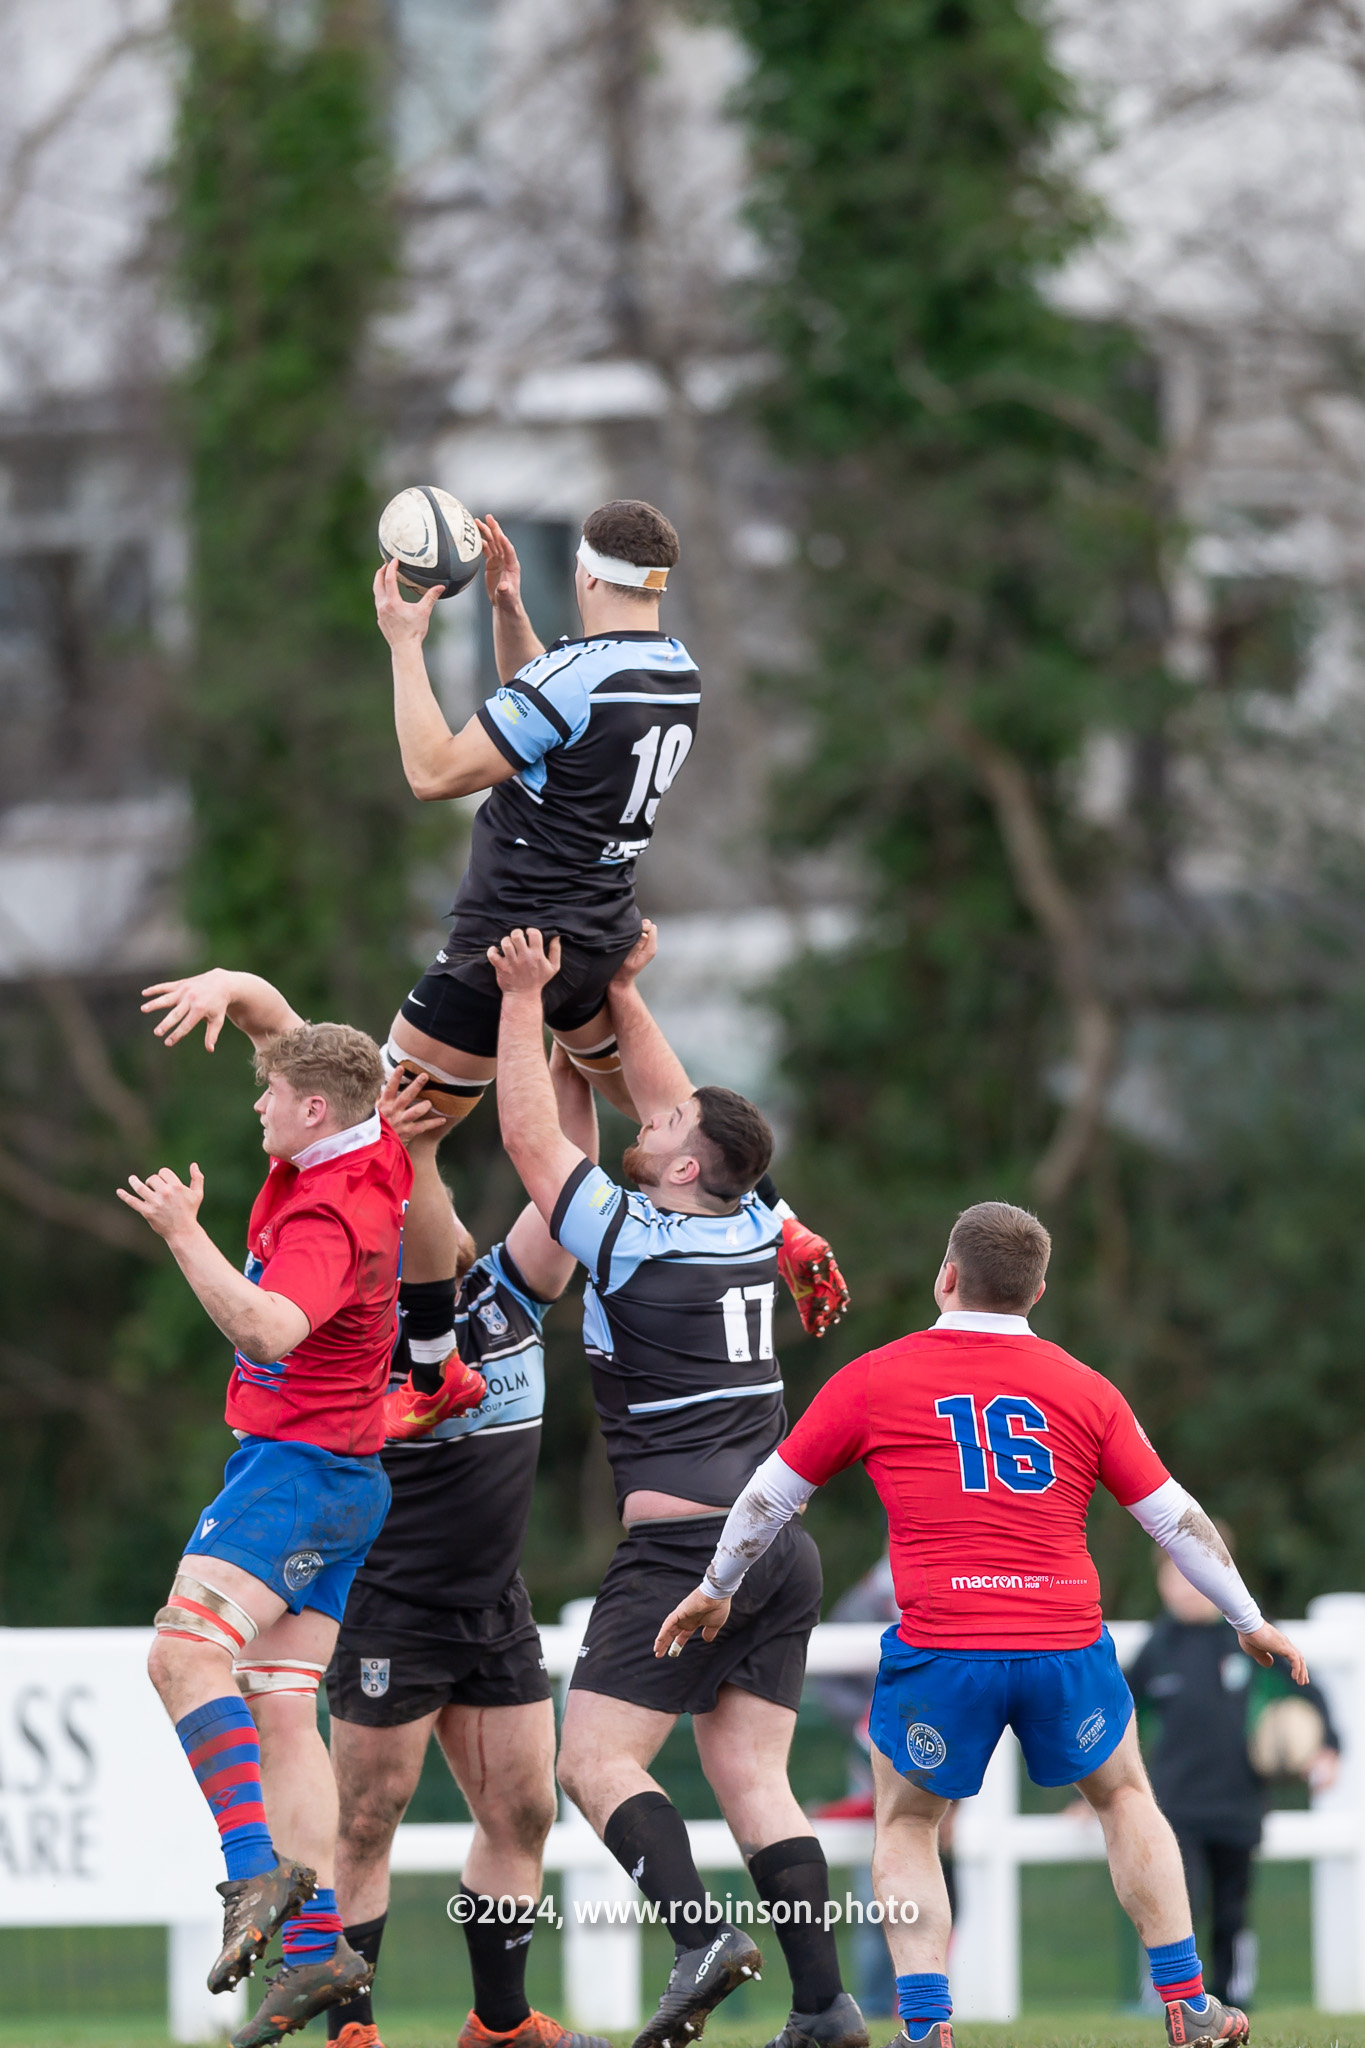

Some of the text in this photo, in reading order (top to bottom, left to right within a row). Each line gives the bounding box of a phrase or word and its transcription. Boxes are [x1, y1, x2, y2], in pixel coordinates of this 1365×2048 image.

[619, 724, 693, 825] 19
[716, 1281, 775, 1363] 17
[934, 1394, 1058, 1494] 16
[951, 1575, 1023, 1590] macron
[0, 1683, 98, 1797] SS
[1171, 2008, 1184, 2041] KAKARI
